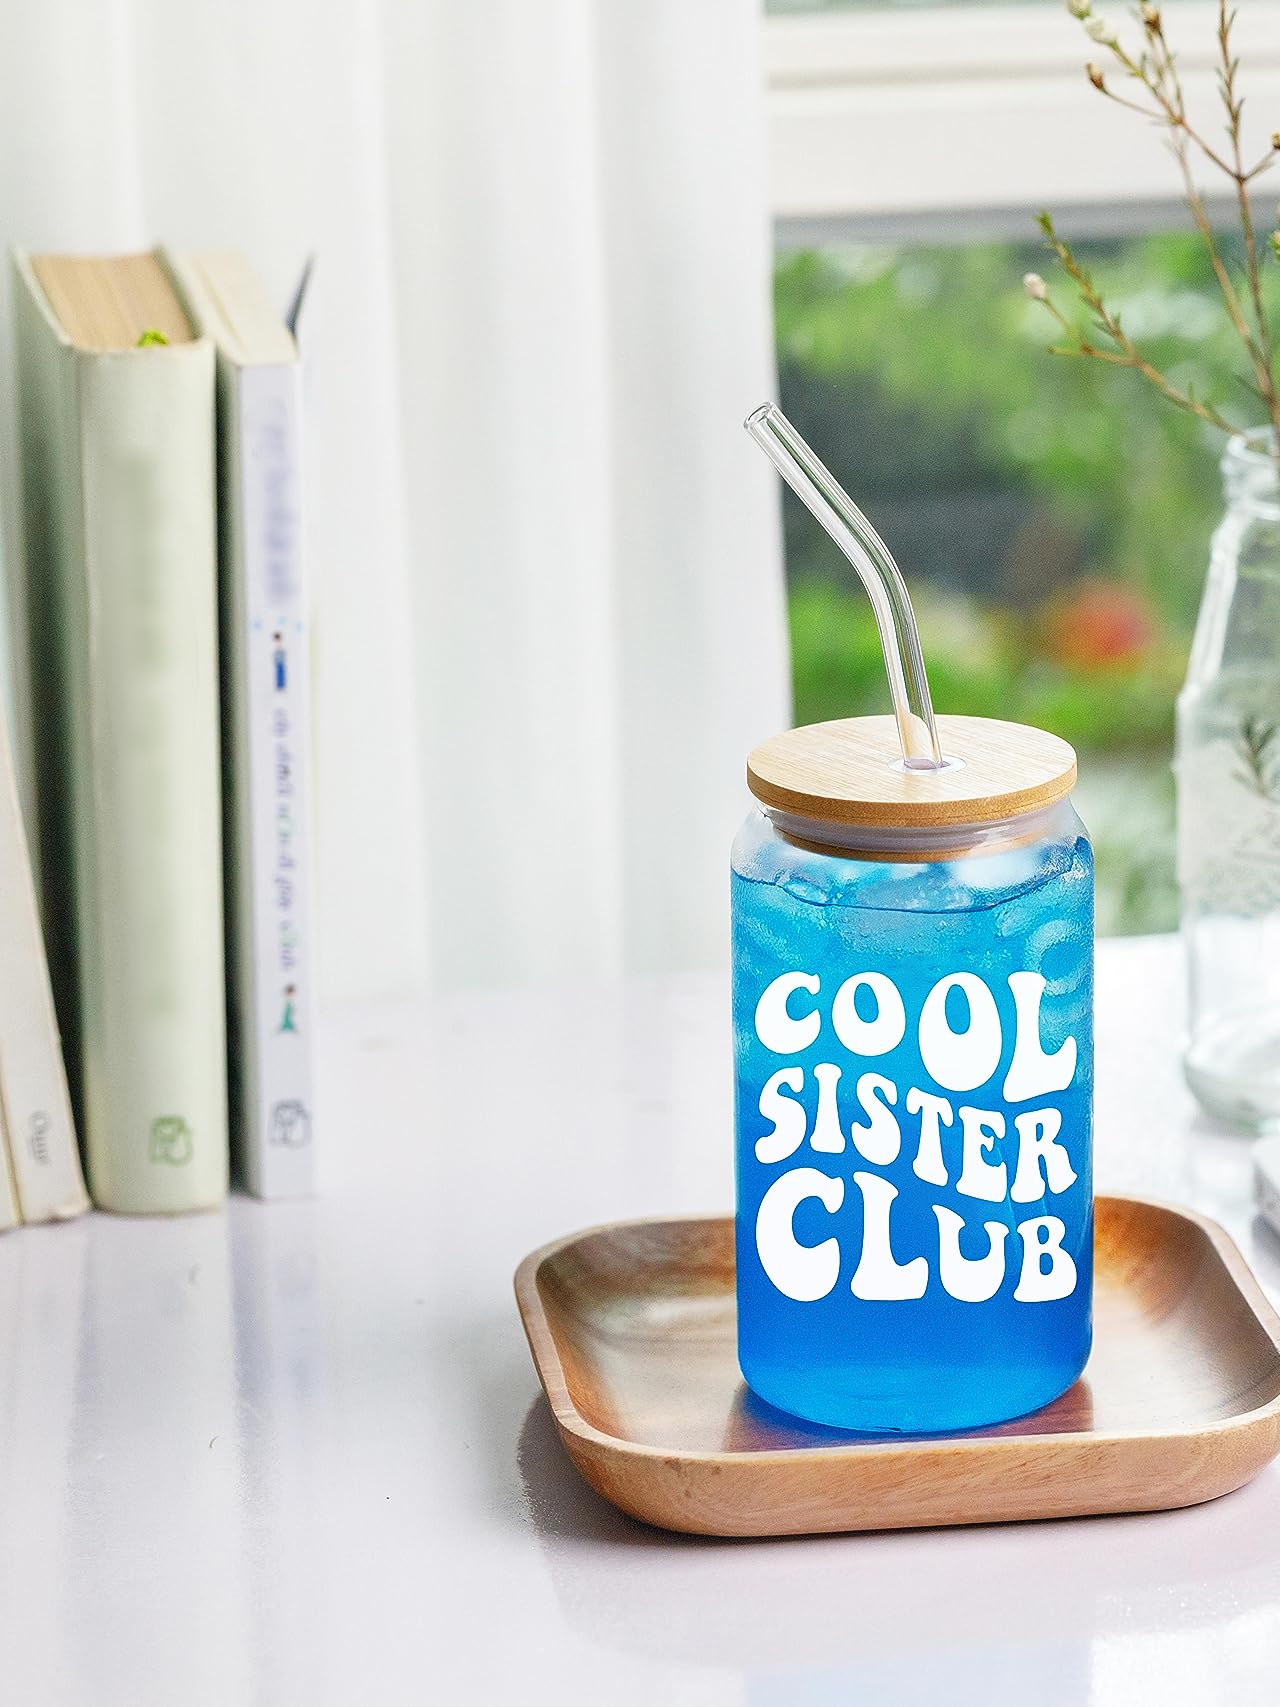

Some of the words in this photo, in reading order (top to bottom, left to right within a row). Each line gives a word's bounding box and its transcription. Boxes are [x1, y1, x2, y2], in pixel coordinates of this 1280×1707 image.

[754, 971, 1078, 1103] COOL
[754, 1063, 1078, 1203] SISTER
[755, 1167, 1078, 1303] CLUB
